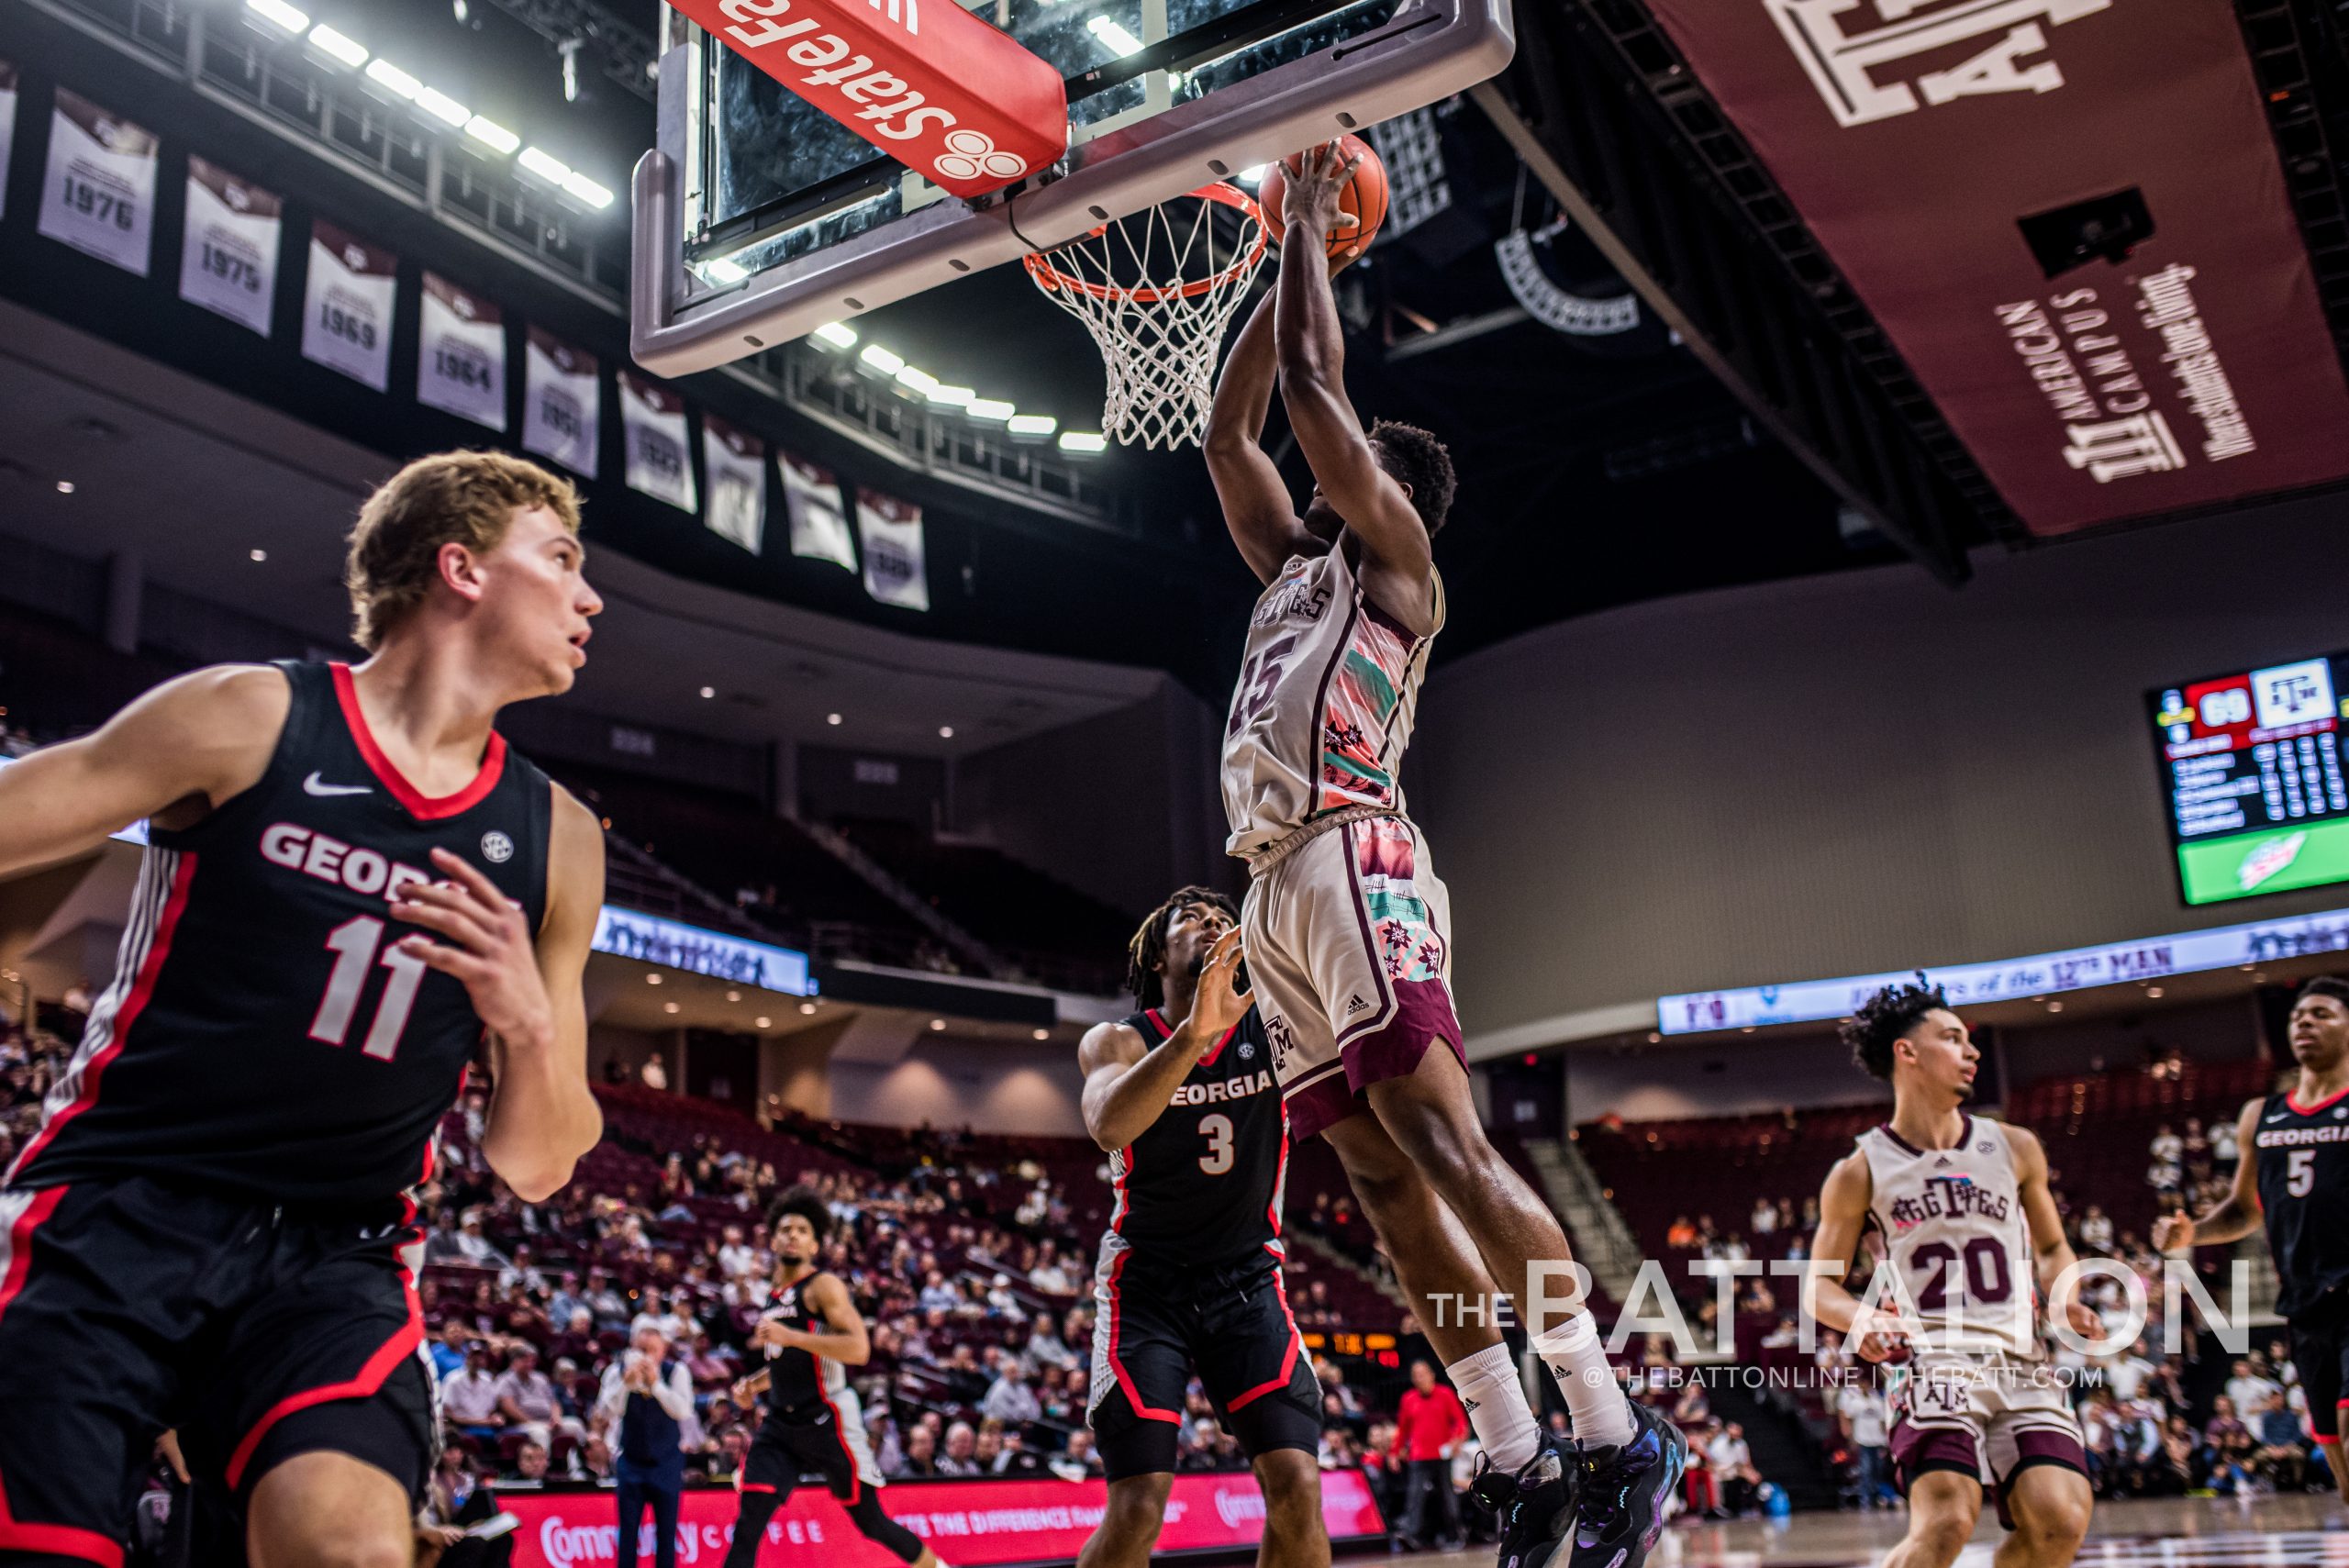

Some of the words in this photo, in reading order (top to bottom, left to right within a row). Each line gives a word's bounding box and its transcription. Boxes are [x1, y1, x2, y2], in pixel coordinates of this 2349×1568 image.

[63, 174, 134, 231] 1976
[202, 240, 261, 295] 1975
[1993, 298, 2101, 420] AMERICAN
[2049, 287, 2150, 413] CAMPUS
[1229, 631, 1299, 741] 15
[260, 822, 522, 911] GEOR
[306, 913, 436, 1062] 11
[1347, 1002, 1369, 1016] adidas
[1169, 1069, 1273, 1106] EORGIA
[1198, 1113, 1234, 1175] 3
[2287, 1149, 2317, 1198] 5
[1910, 1236, 2012, 1312] 20
[540, 1516, 698, 1568] Commy
[701, 1518, 824, 1548] COFEE
